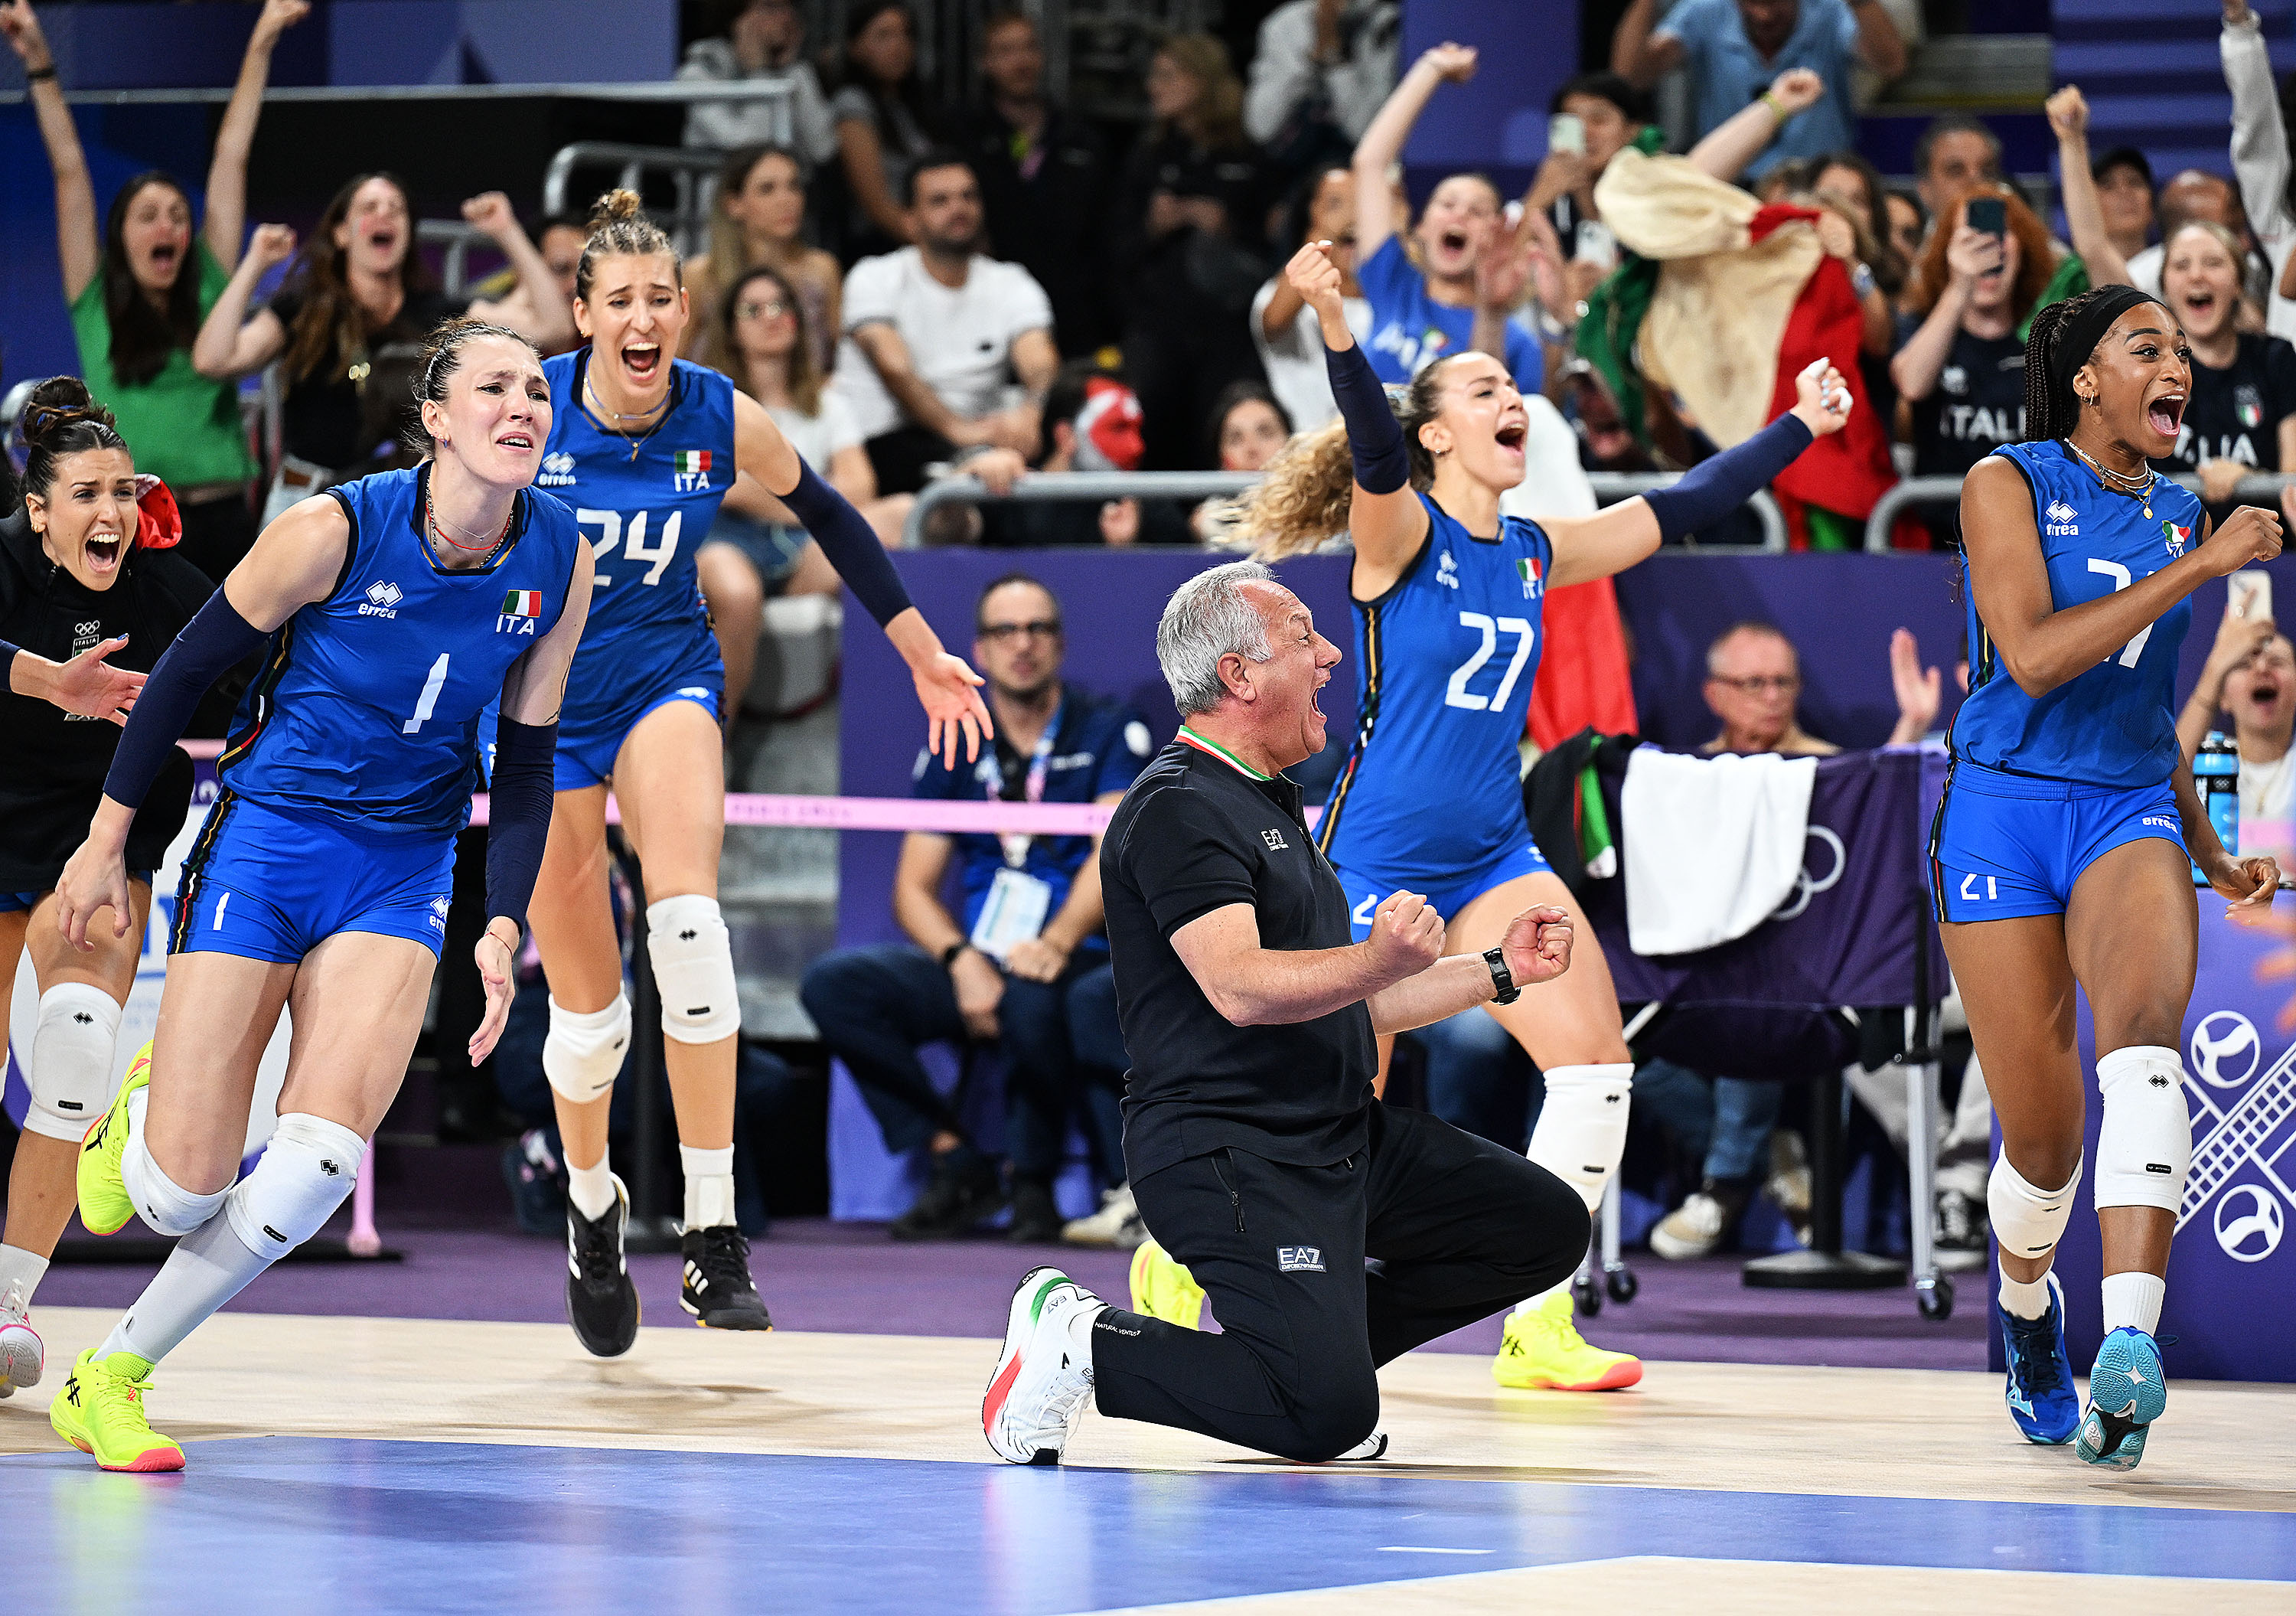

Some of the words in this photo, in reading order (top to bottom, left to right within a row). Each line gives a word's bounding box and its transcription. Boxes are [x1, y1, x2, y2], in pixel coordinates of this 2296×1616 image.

[674, 472, 710, 492] ITA
[576, 508, 682, 587] 24
[495, 615, 535, 635] ITA
[75, 637, 97, 647] ITALIA
[1445, 610, 1535, 713] 27
[403, 652, 450, 734] 1
[213, 891, 230, 931] 1
[1279, 1247, 1320, 1264] EA7
[1044, 1294, 1068, 1314] EA7
[1094, 1321, 1118, 1333] NATURAL
